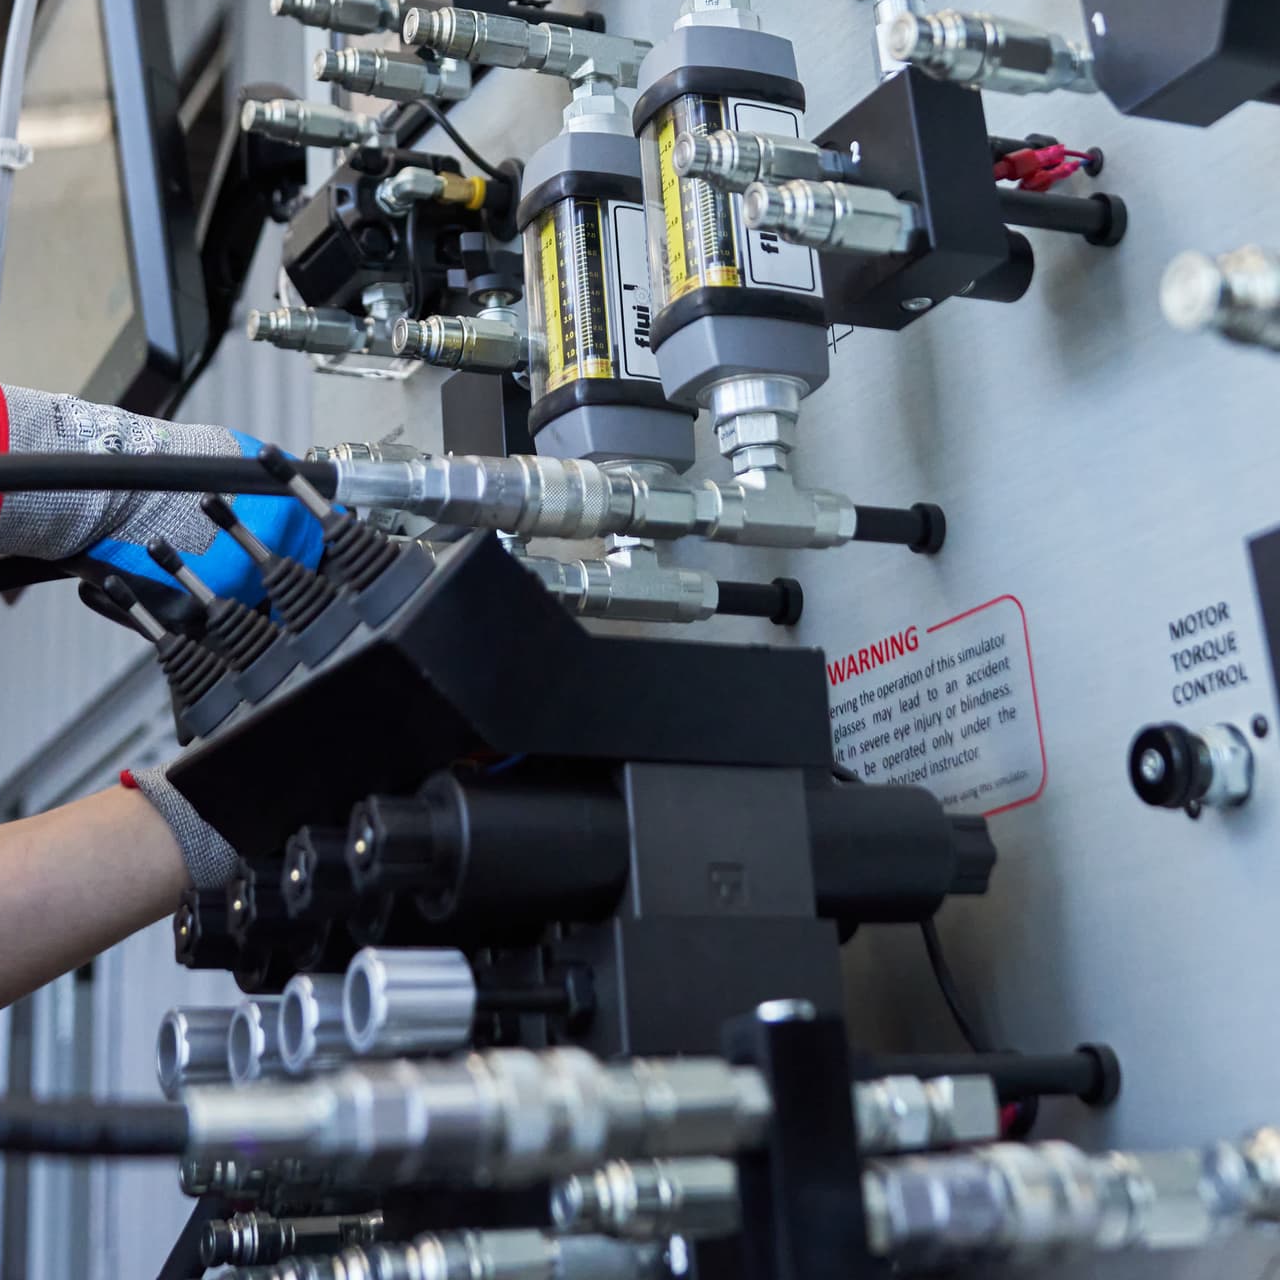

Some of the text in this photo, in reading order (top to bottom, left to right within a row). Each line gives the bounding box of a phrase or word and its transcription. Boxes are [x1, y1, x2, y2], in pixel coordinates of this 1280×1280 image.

[1169, 601, 1230, 640] MOTOR
[827, 625, 919, 686] WARNING
[829, 634, 1006, 719] erving the operation of this simulator
[1170, 631, 1237, 672] TORQUE
[833, 656, 1010, 744] glasses may lead to an accident
[1171, 663, 1249, 704] CONTROL
[847, 744, 857, 759] in
[860, 732, 890, 754] severe
[893, 723, 910, 740] eye
[914, 711, 941, 733] injury
[945, 704, 957, 719] or
[864, 761, 877, 777] be
[882, 738, 926, 770] operated
[932, 729, 953, 750] only
[960, 716, 991, 739] under
[998, 706, 1016, 724] the
